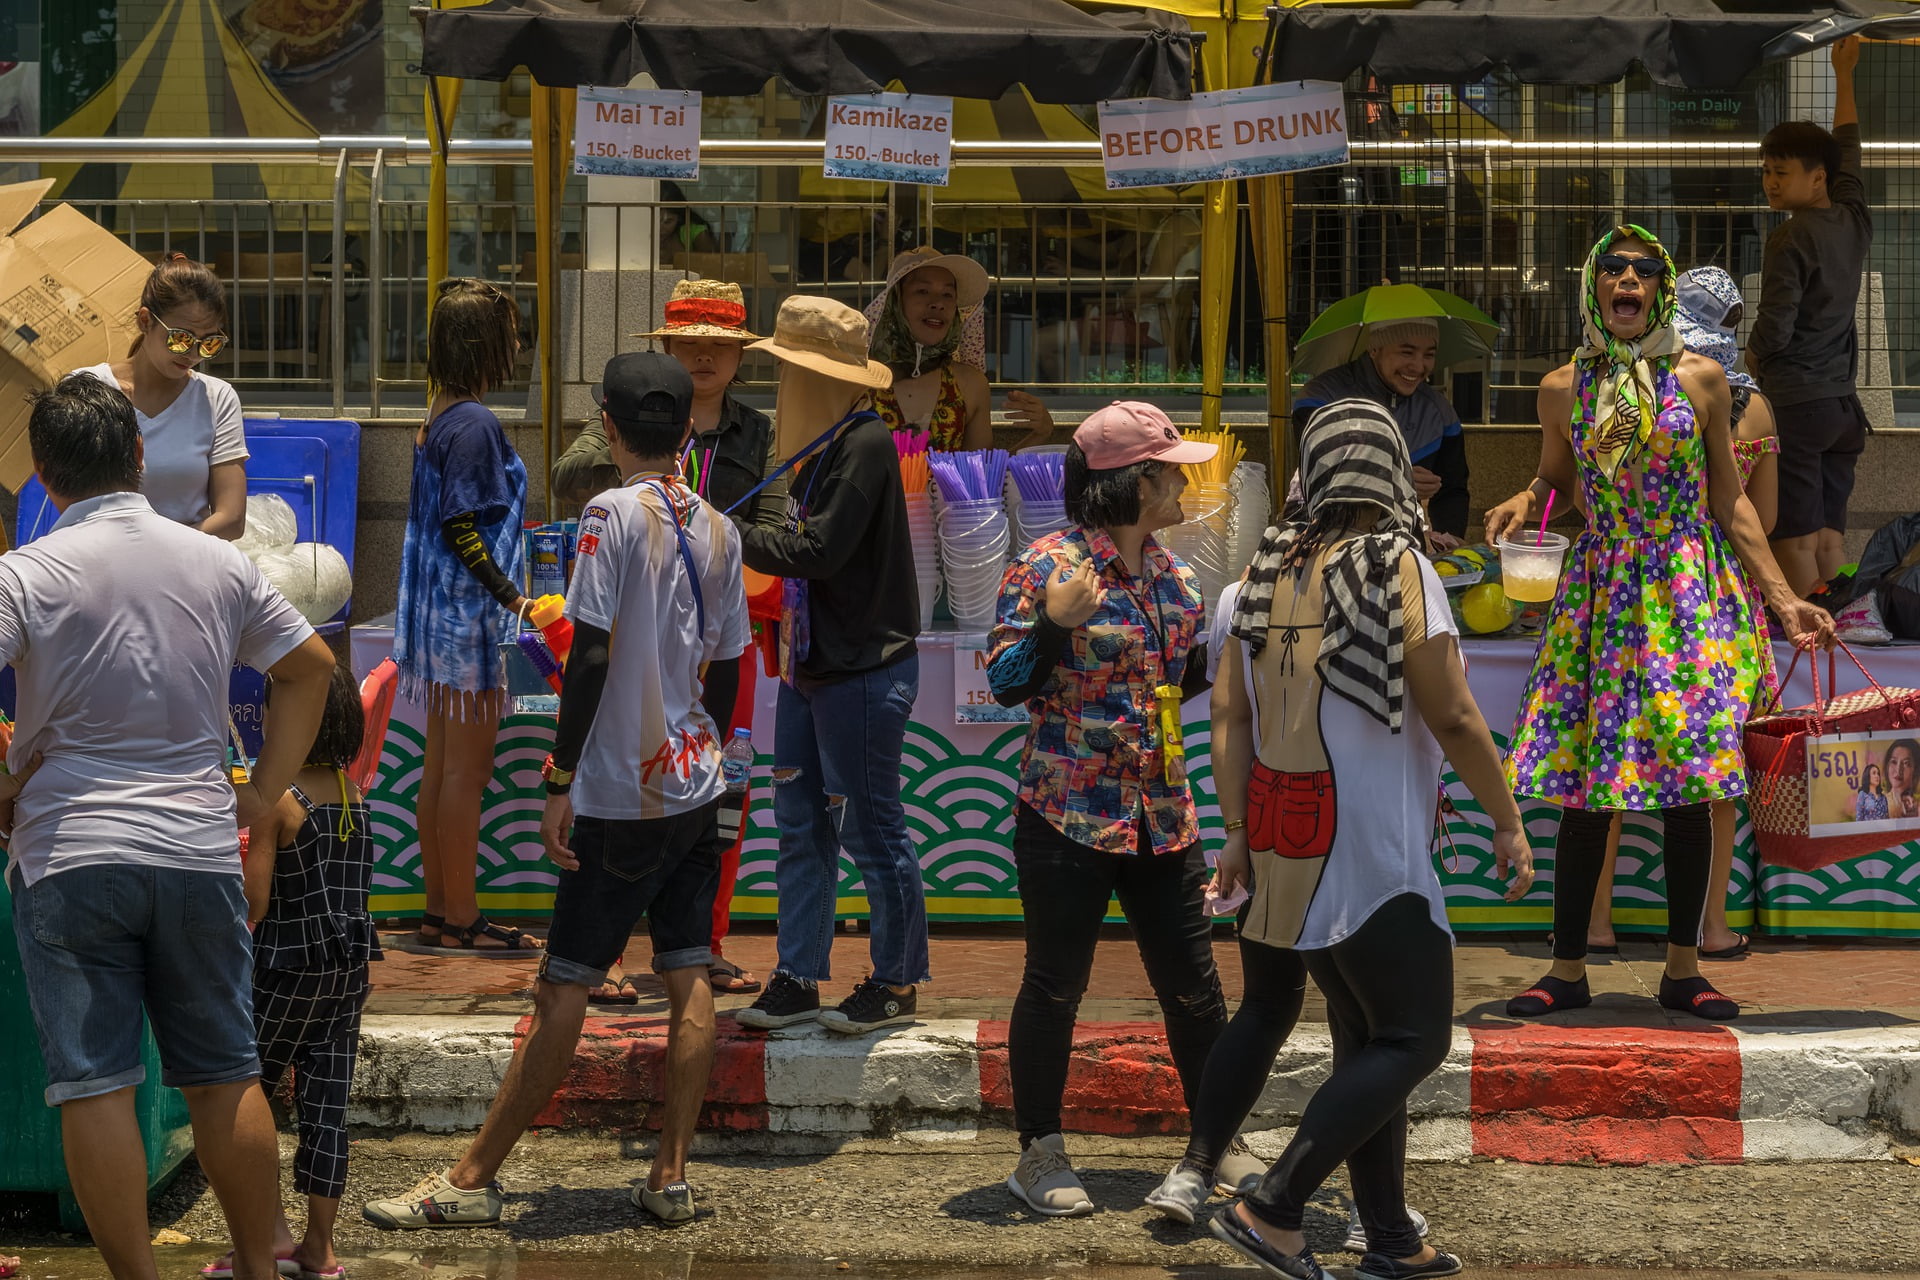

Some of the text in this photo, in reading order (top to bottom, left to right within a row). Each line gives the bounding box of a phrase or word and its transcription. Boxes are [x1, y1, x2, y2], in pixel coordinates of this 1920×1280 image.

[595, 102, 685, 126] Mai Tai
[831, 104, 948, 133] Kamikaze
[1702, 98, 1742, 114] Daily
[1105, 107, 1343, 157] BEFORE DRUNK
[1810, 750, 1859, 790] เรณู
